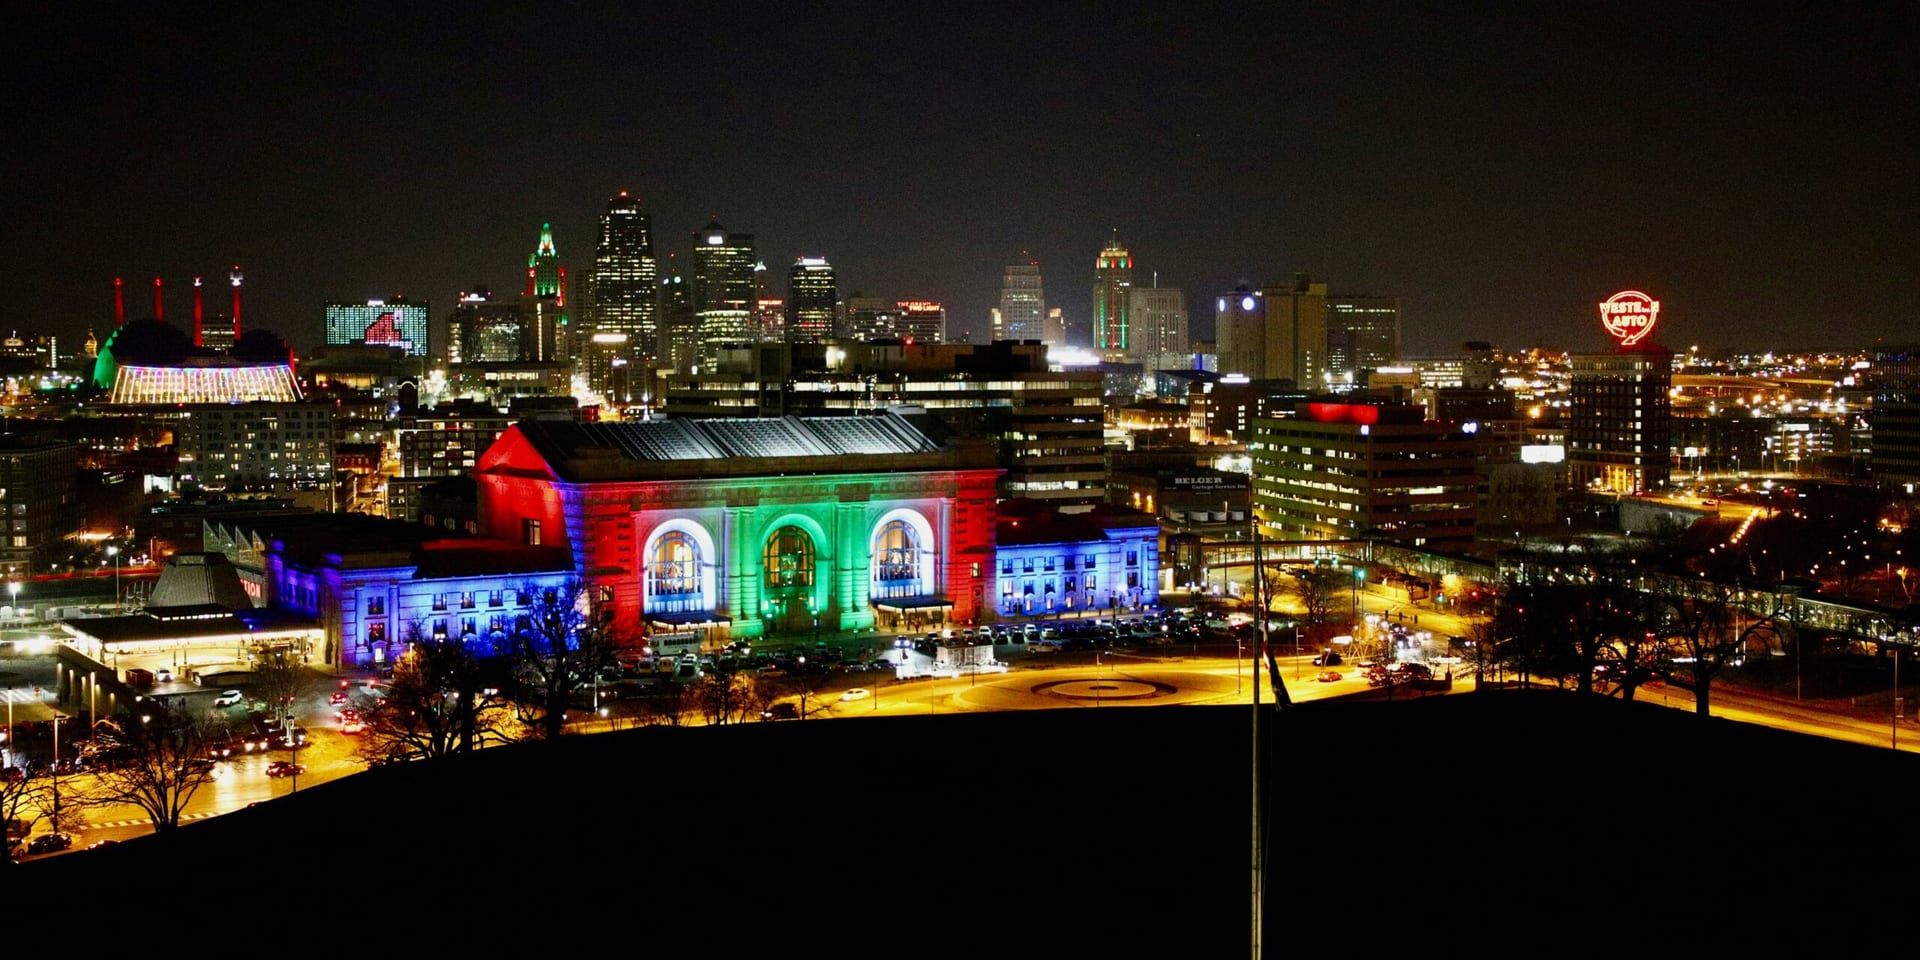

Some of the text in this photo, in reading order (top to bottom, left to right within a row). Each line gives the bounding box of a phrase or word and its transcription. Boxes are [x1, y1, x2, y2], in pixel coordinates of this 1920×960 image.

[1599, 301, 1660, 313] WESTEN
[1612, 315, 1648, 327] AUTO
[1174, 477, 1222, 485] BELGER
[240, 578, 261, 598] TION
